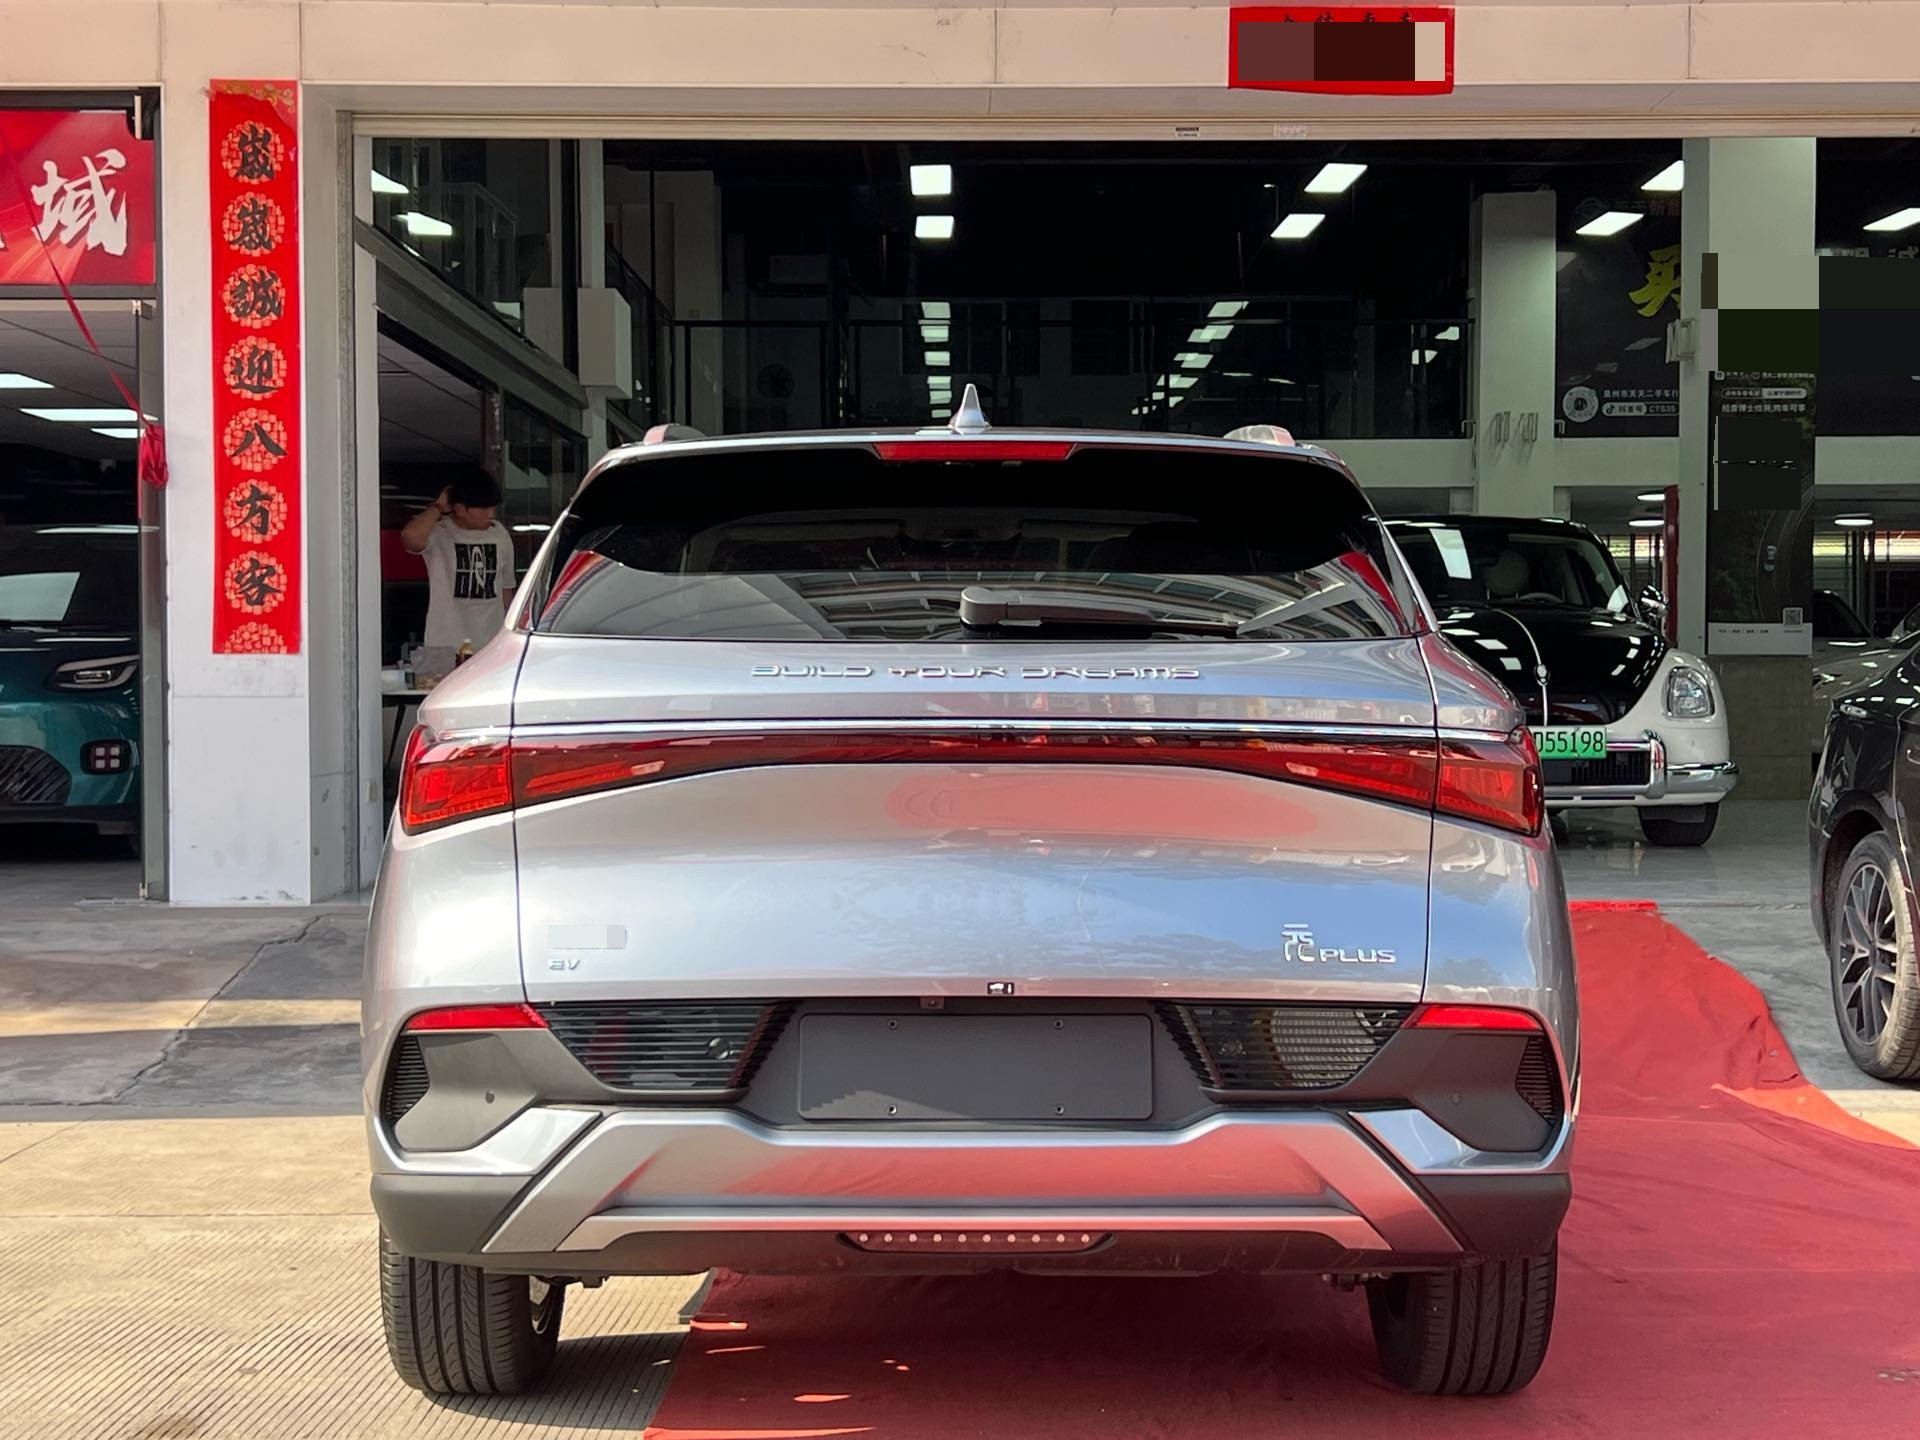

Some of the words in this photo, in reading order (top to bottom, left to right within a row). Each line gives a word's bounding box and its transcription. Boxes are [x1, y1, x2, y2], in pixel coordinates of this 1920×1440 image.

[31, 149, 127, 256] 域
[751, 664, 874, 678] BUILD
[888, 664, 1007, 679] YOUR
[1021, 665, 1201, 680] DREAMS
[1281, 922, 1316, 963] 元
[1319, 947, 1397, 964] PLUS
